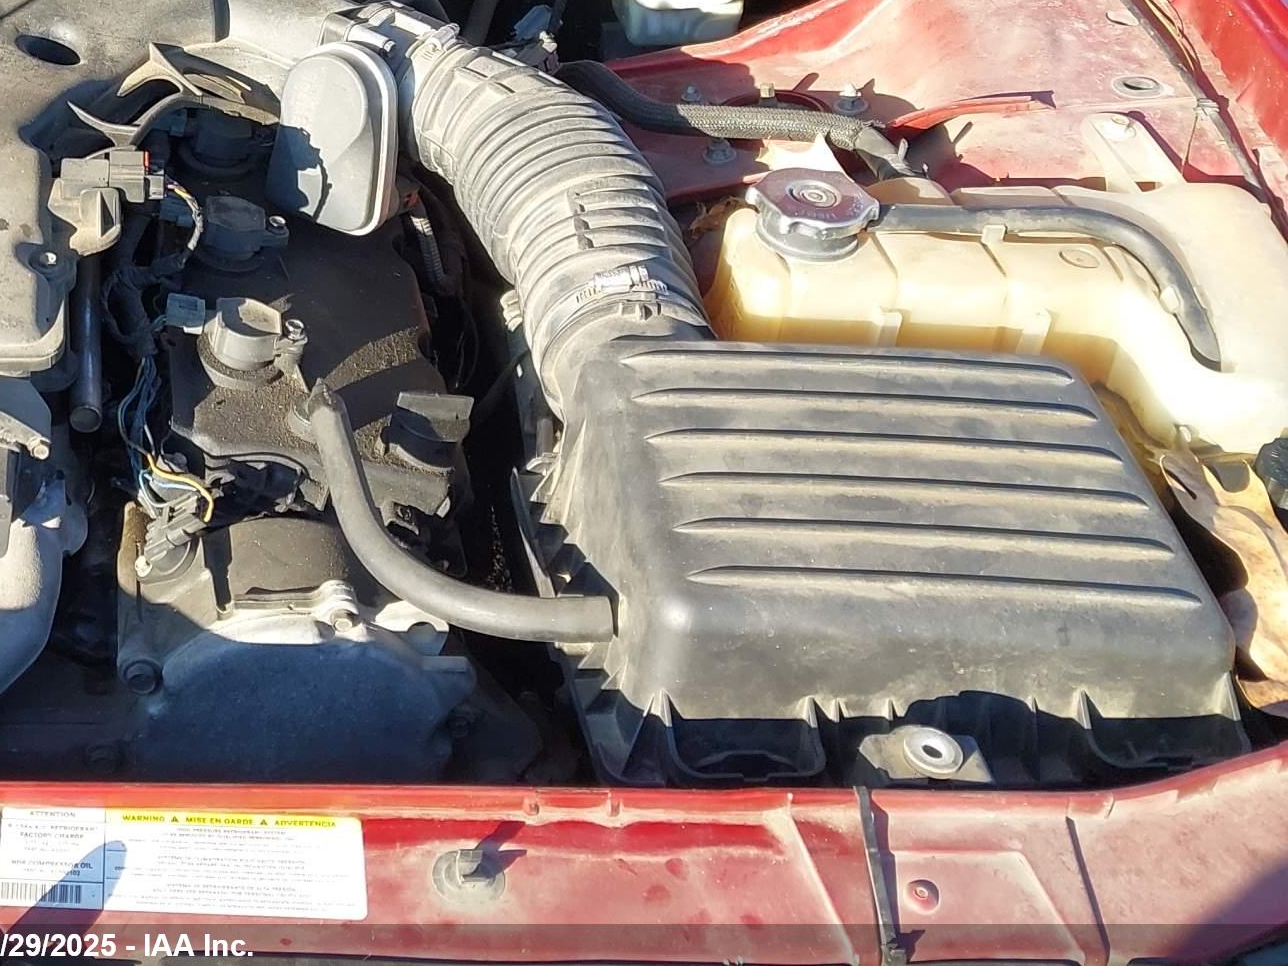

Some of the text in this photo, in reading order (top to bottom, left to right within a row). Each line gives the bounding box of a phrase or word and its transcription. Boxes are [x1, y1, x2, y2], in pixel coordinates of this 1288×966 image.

[29, 810, 76, 818] ATTENTION
[122, 815, 166, 823] WARNING
[185, 816, 208, 824] MISE
[274, 820, 337, 828] ADVERTENCIA
[80, 862, 94, 870] OIL
